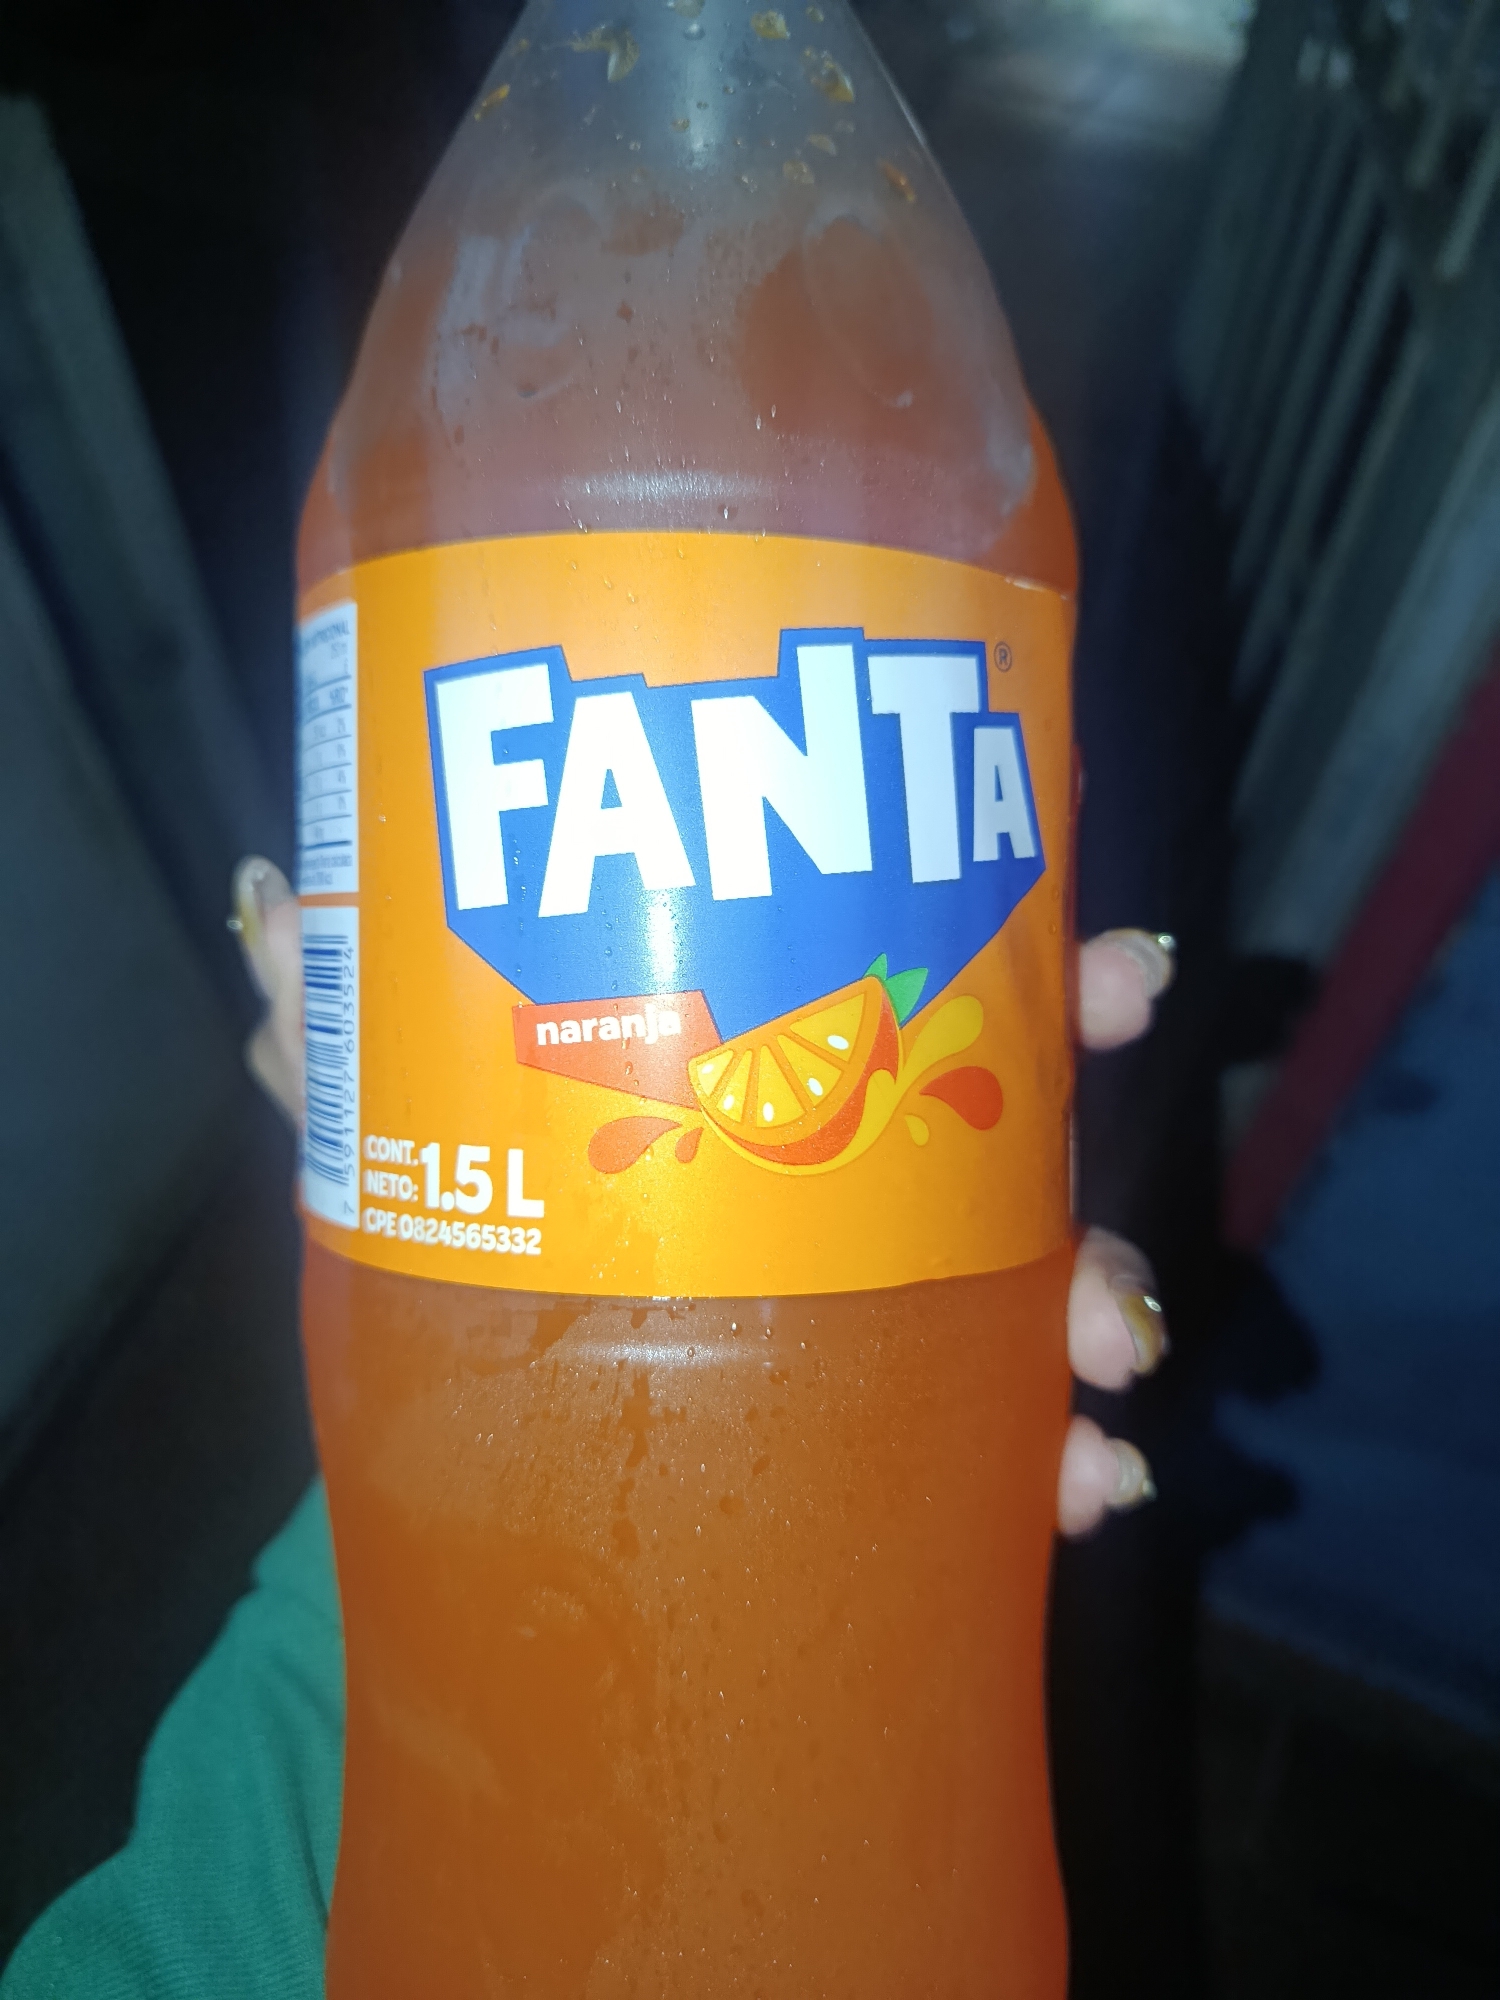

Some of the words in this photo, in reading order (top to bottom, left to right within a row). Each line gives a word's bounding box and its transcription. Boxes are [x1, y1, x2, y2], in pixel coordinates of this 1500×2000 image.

[434, 644, 1037, 918] FANTA
[536, 1003, 682, 1045] naranja
[364, 1134, 418, 1166] CONT.
[364, 1169, 418, 1202] NETO:
[420, 1142, 493, 1214] 1.5
[507, 1148, 545, 1218] L
[364, 1207, 397, 1236] CPE
